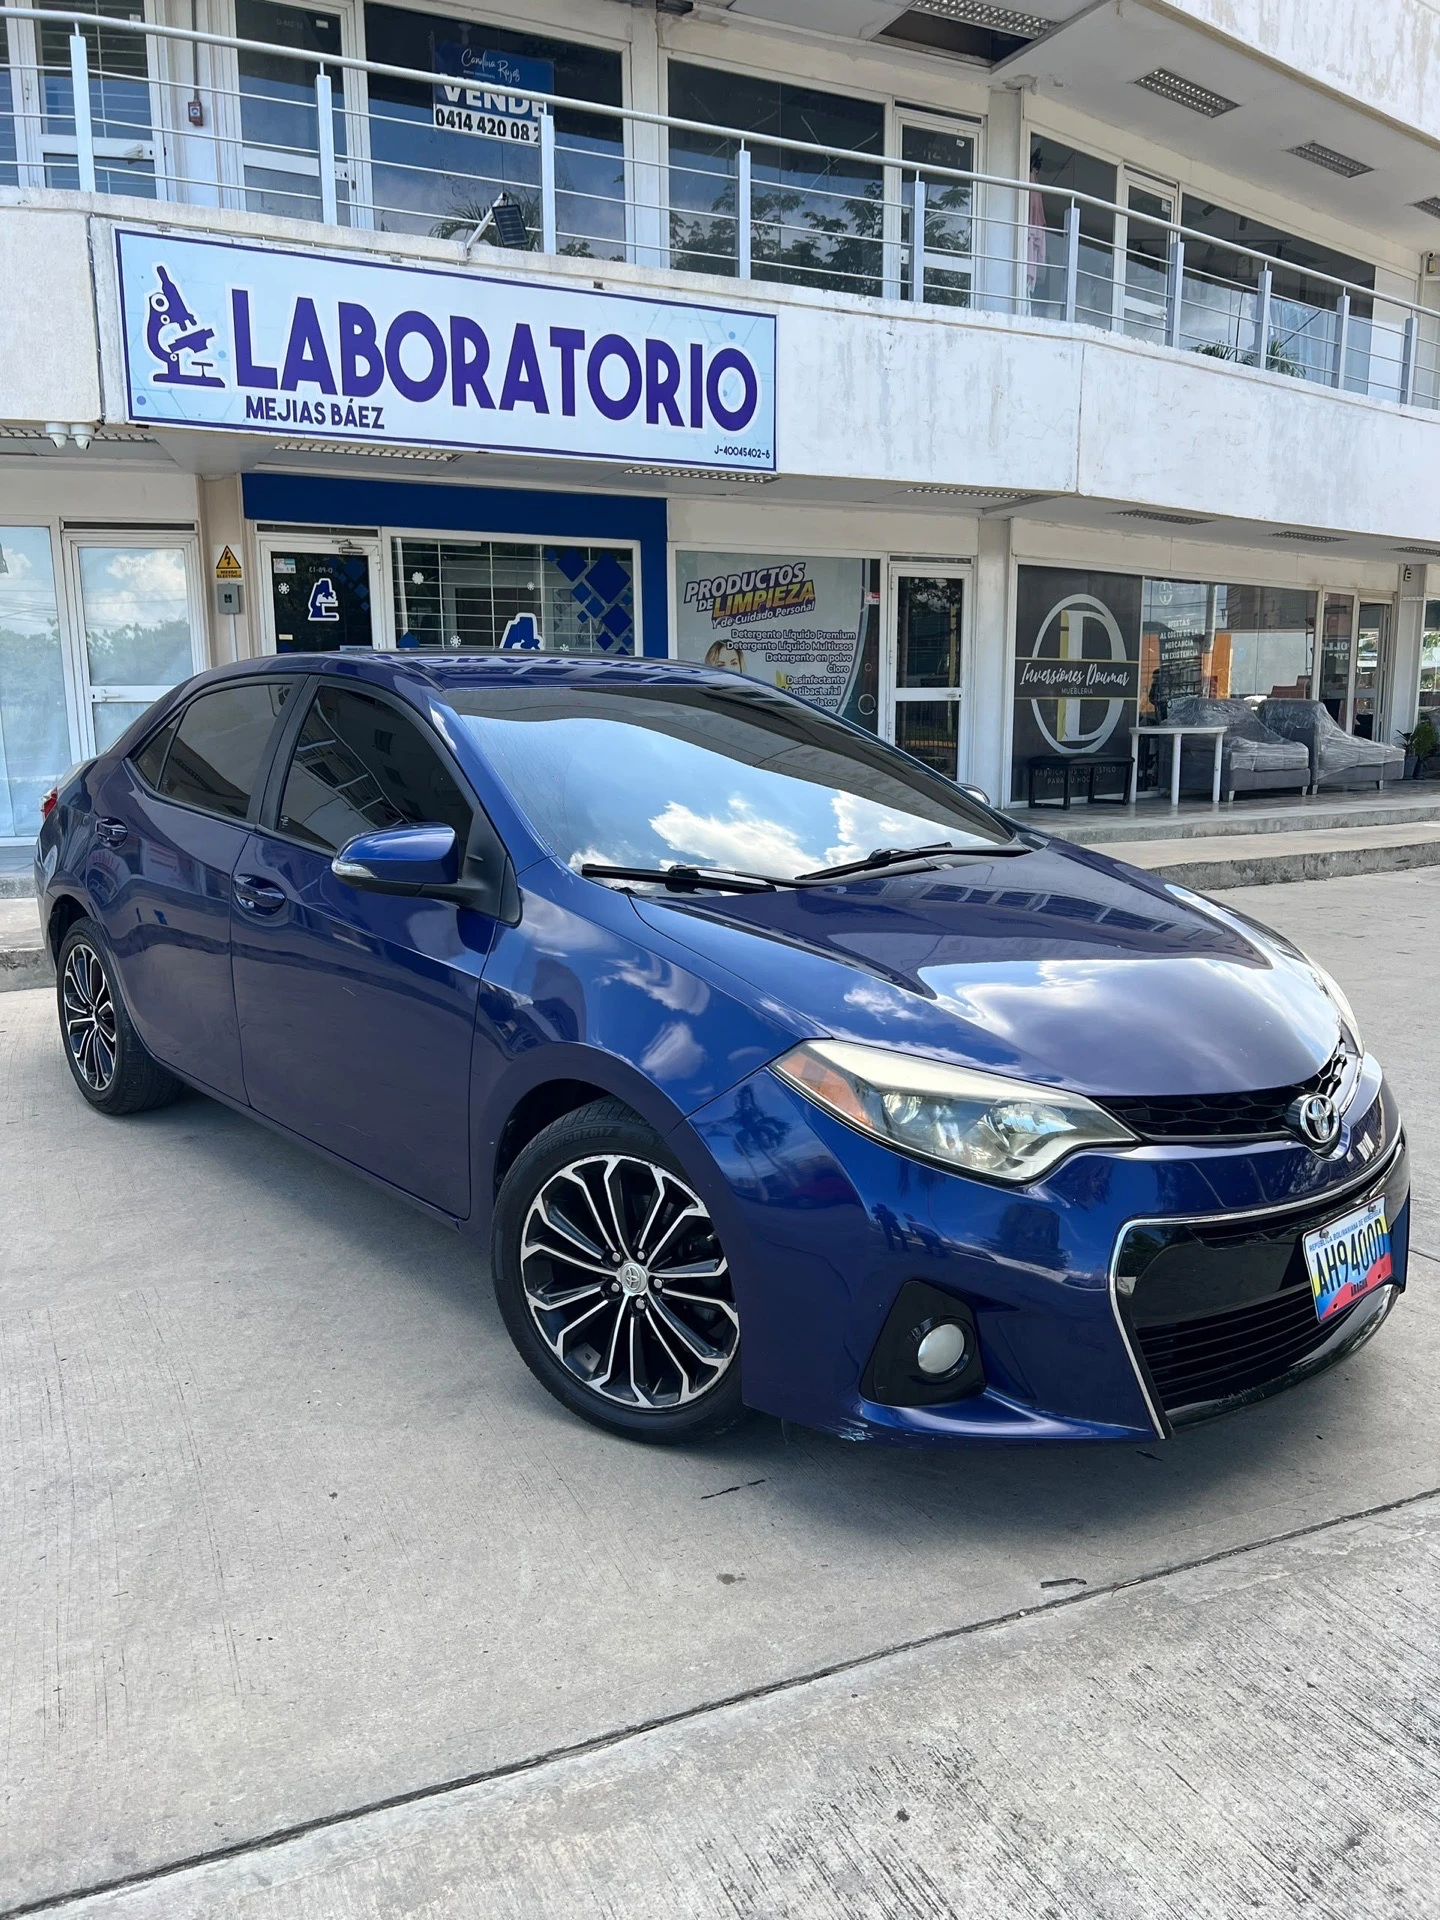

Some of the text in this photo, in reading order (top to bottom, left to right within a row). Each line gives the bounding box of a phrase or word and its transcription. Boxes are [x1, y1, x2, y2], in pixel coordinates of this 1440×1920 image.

[461, 48, 496, 73] Carolina
[435, 107, 473, 132] 0414
[476, 118, 507, 138] 420
[510, 122, 530, 141] 08
[232, 289, 758, 432] LABORATORIO
[245, 396, 385, 429] MEJIAS BÁEZ
[684, 563, 805, 603] PRODUCTOS
[698, 581, 815, 618] DE LIMPIEZA
[720, 616, 736, 628] de
[735, 608, 774, 625] Cuidado
[775, 601, 815, 617] Personal
[727, 641, 854, 652] Detergente Líquido Multiusos
[731, 629, 856, 641] Detergente Líquido Premium
[766, 653, 853, 664] Detergente en polvo
[827, 663, 850, 673] Cloro
[786, 675, 846, 685] Desinfectante
[1019, 662, 1085, 685] Inversiones
